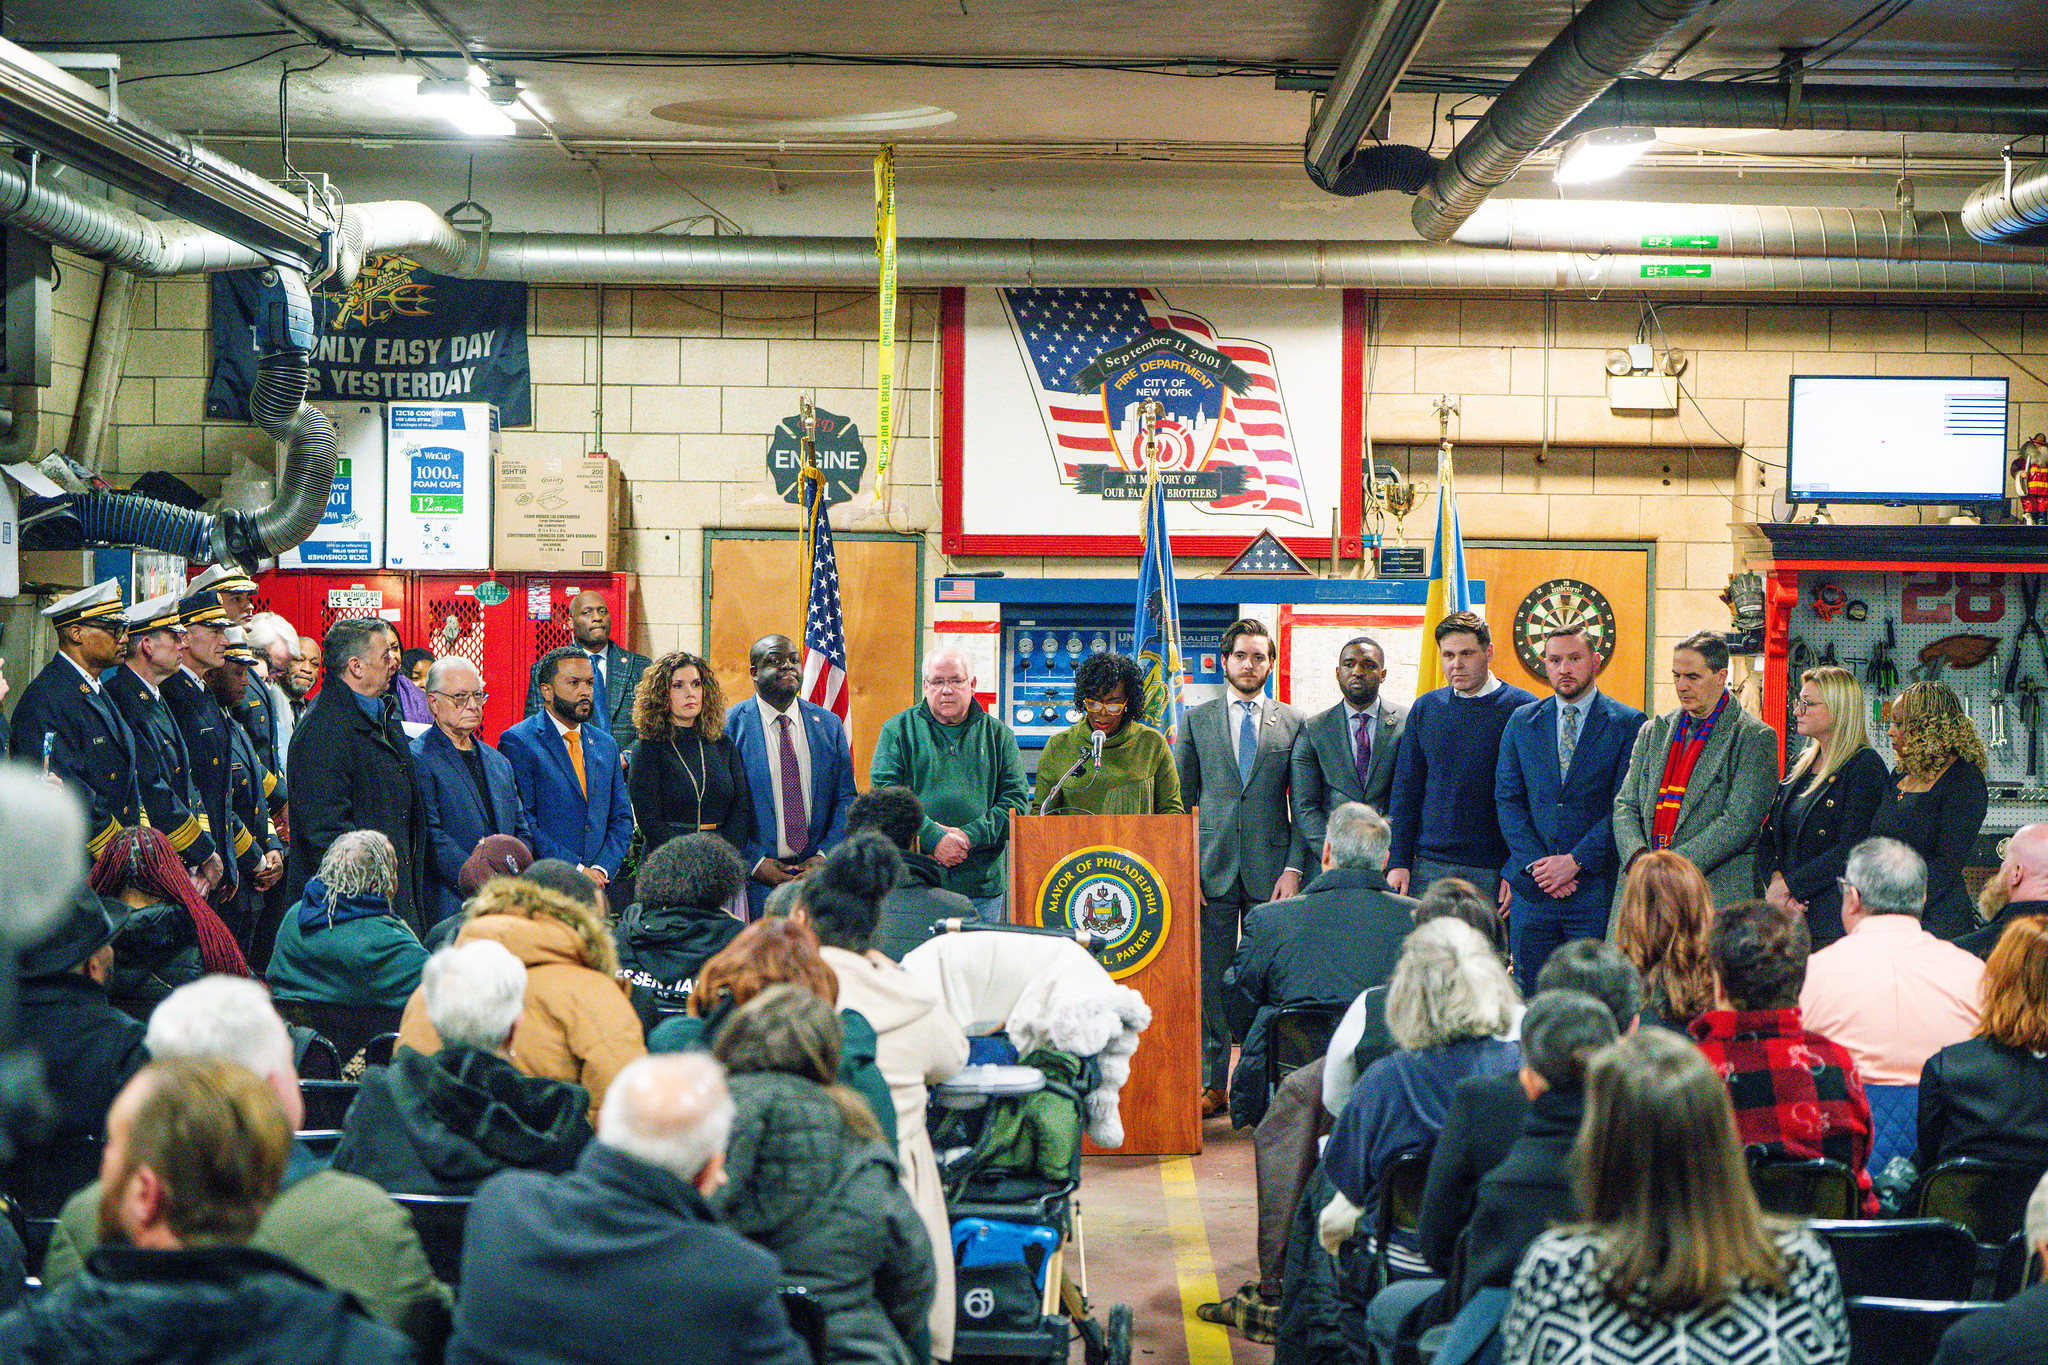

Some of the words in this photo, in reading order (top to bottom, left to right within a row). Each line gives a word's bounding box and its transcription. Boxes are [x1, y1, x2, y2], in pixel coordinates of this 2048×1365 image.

[1648, 237, 1672, 246] EF-2
[1647, 267, 1668, 276] EF-1
[376, 338, 444, 365] EASY
[450, 330, 496, 362] DAY
[1105, 337, 1172, 368] September
[1174, 340, 1187, 353] 11
[1189, 349, 1221, 369] 2001
[1114, 367, 1138, 391] FIRE
[1140, 359, 1215, 390] DEPARTMENT
[332, 367, 476, 398] YESTERDAY
[1144, 379, 1168, 388] CITY
[1171, 379, 1186, 387] OF
[1136, 388, 1160, 397] NEW
[1164, 388, 1192, 397] YORK
[424, 452, 450, 461] WinCup
[775, 450, 860, 469] ENGINE
[1126, 475, 1137, 484] IN
[1184, 475, 1197, 484] OF
[1105, 488, 1125, 498] OUR
[1167, 489, 1217, 498] BROTHERS
[417, 497, 434, 512] 12
[1551, 584, 1580, 593] unicorn
[330, 598, 341, 606] IS
[347, 598, 380, 606] STUPID
[1902, 571, 2005, 623] 28
[1049, 871, 1075, 913] MAYOR
[1076, 860, 1093, 873] OF
[1096, 857, 1157, 914] PHILADELPHIA
[1103, 955, 1113, 965] L.
[1116, 929, 1152, 962] PARKER
